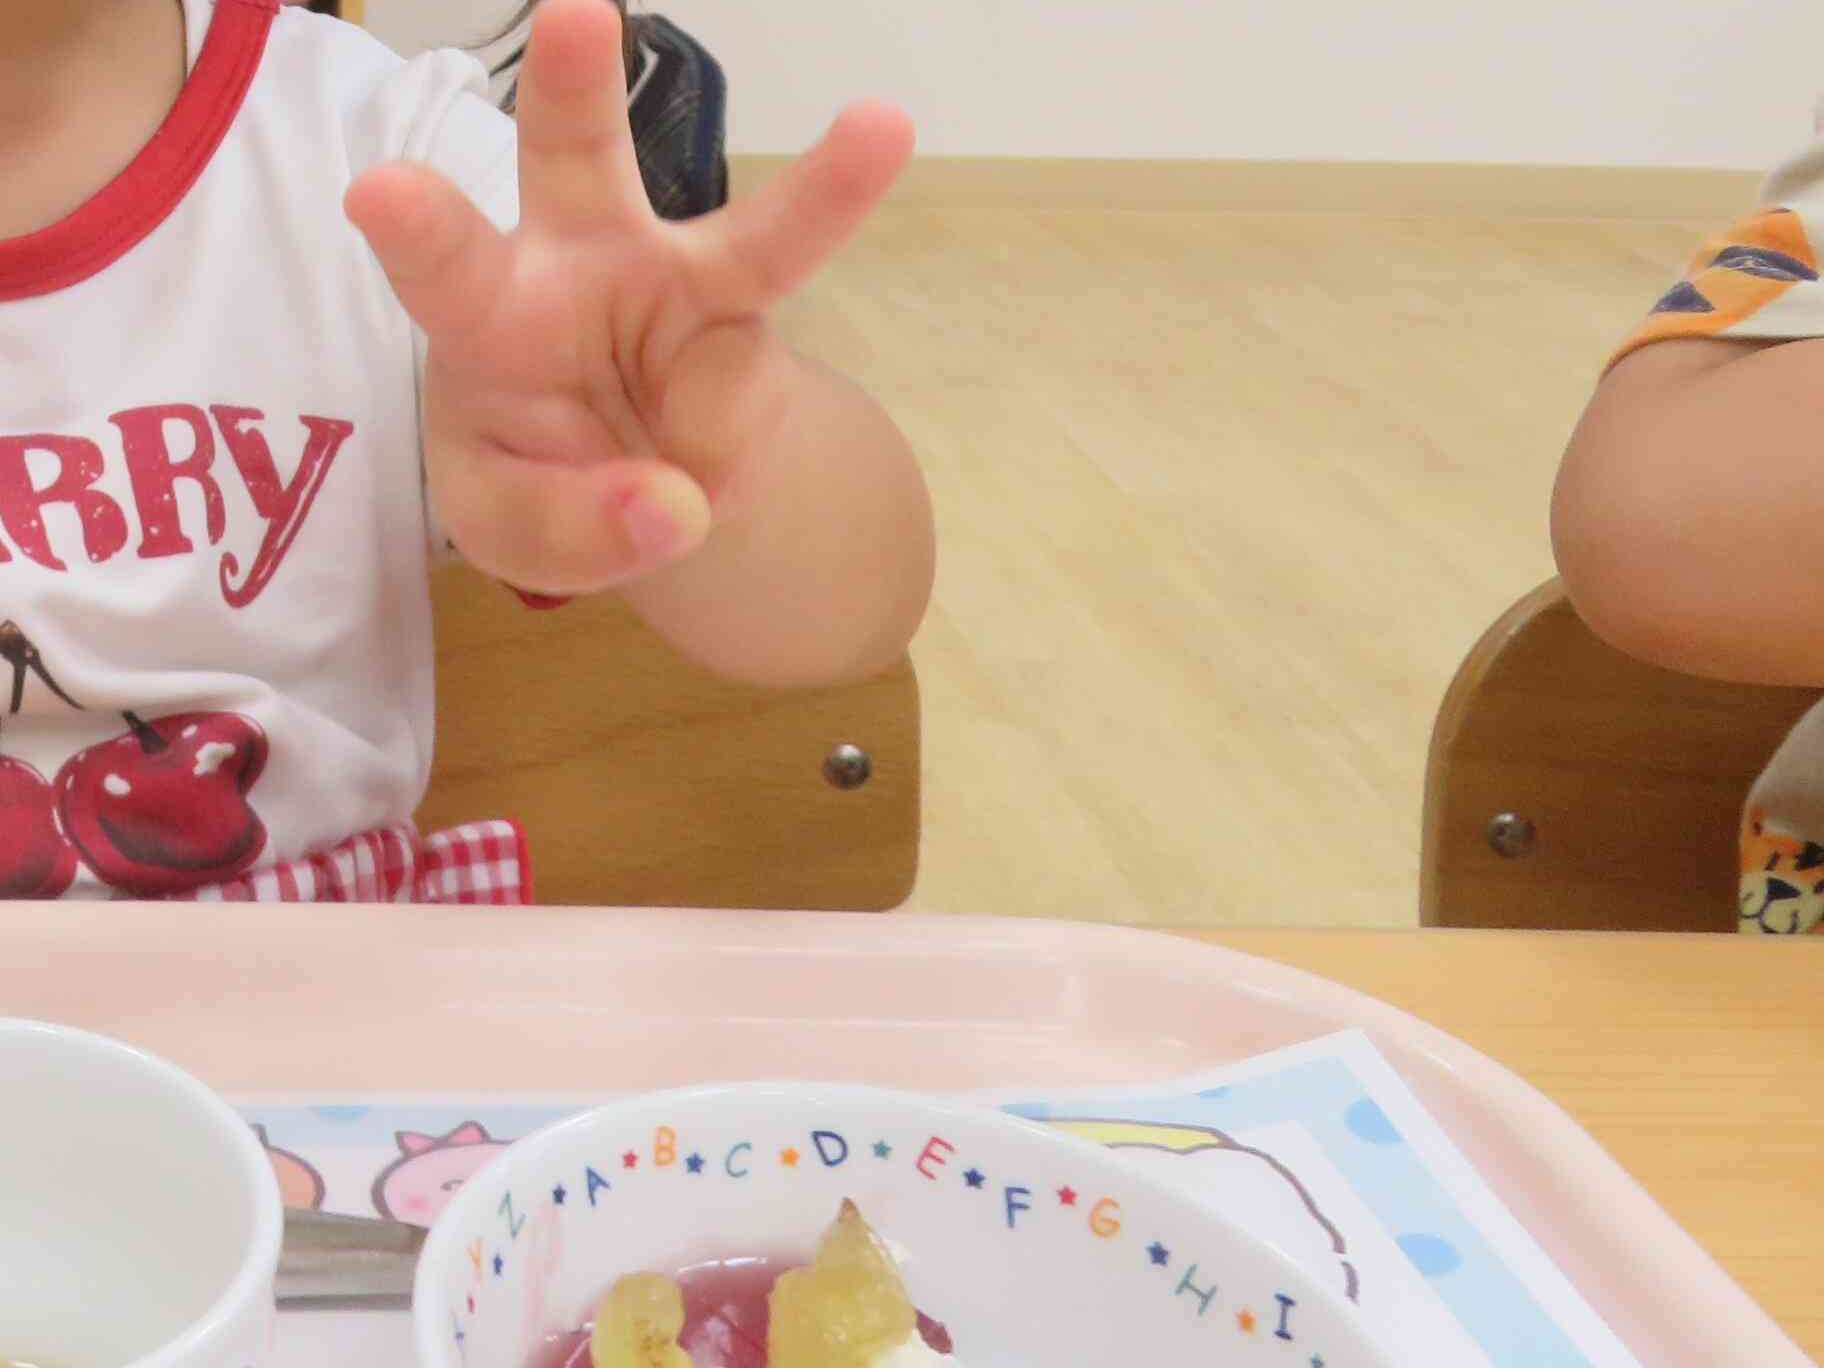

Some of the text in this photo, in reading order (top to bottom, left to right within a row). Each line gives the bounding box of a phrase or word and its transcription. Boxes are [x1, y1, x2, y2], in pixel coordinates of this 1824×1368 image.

[585, 1165, 612, 1207] A
[653, 1125, 676, 1167] B
[725, 1141, 753, 1178] C
[811, 1129, 849, 1168] D
[916, 1135, 956, 1181] E
[1004, 1185, 1032, 1230] F
[1087, 1195, 1122, 1240] G
[1174, 1263, 1218, 1317] H
[1274, 1292, 1297, 1342] I
